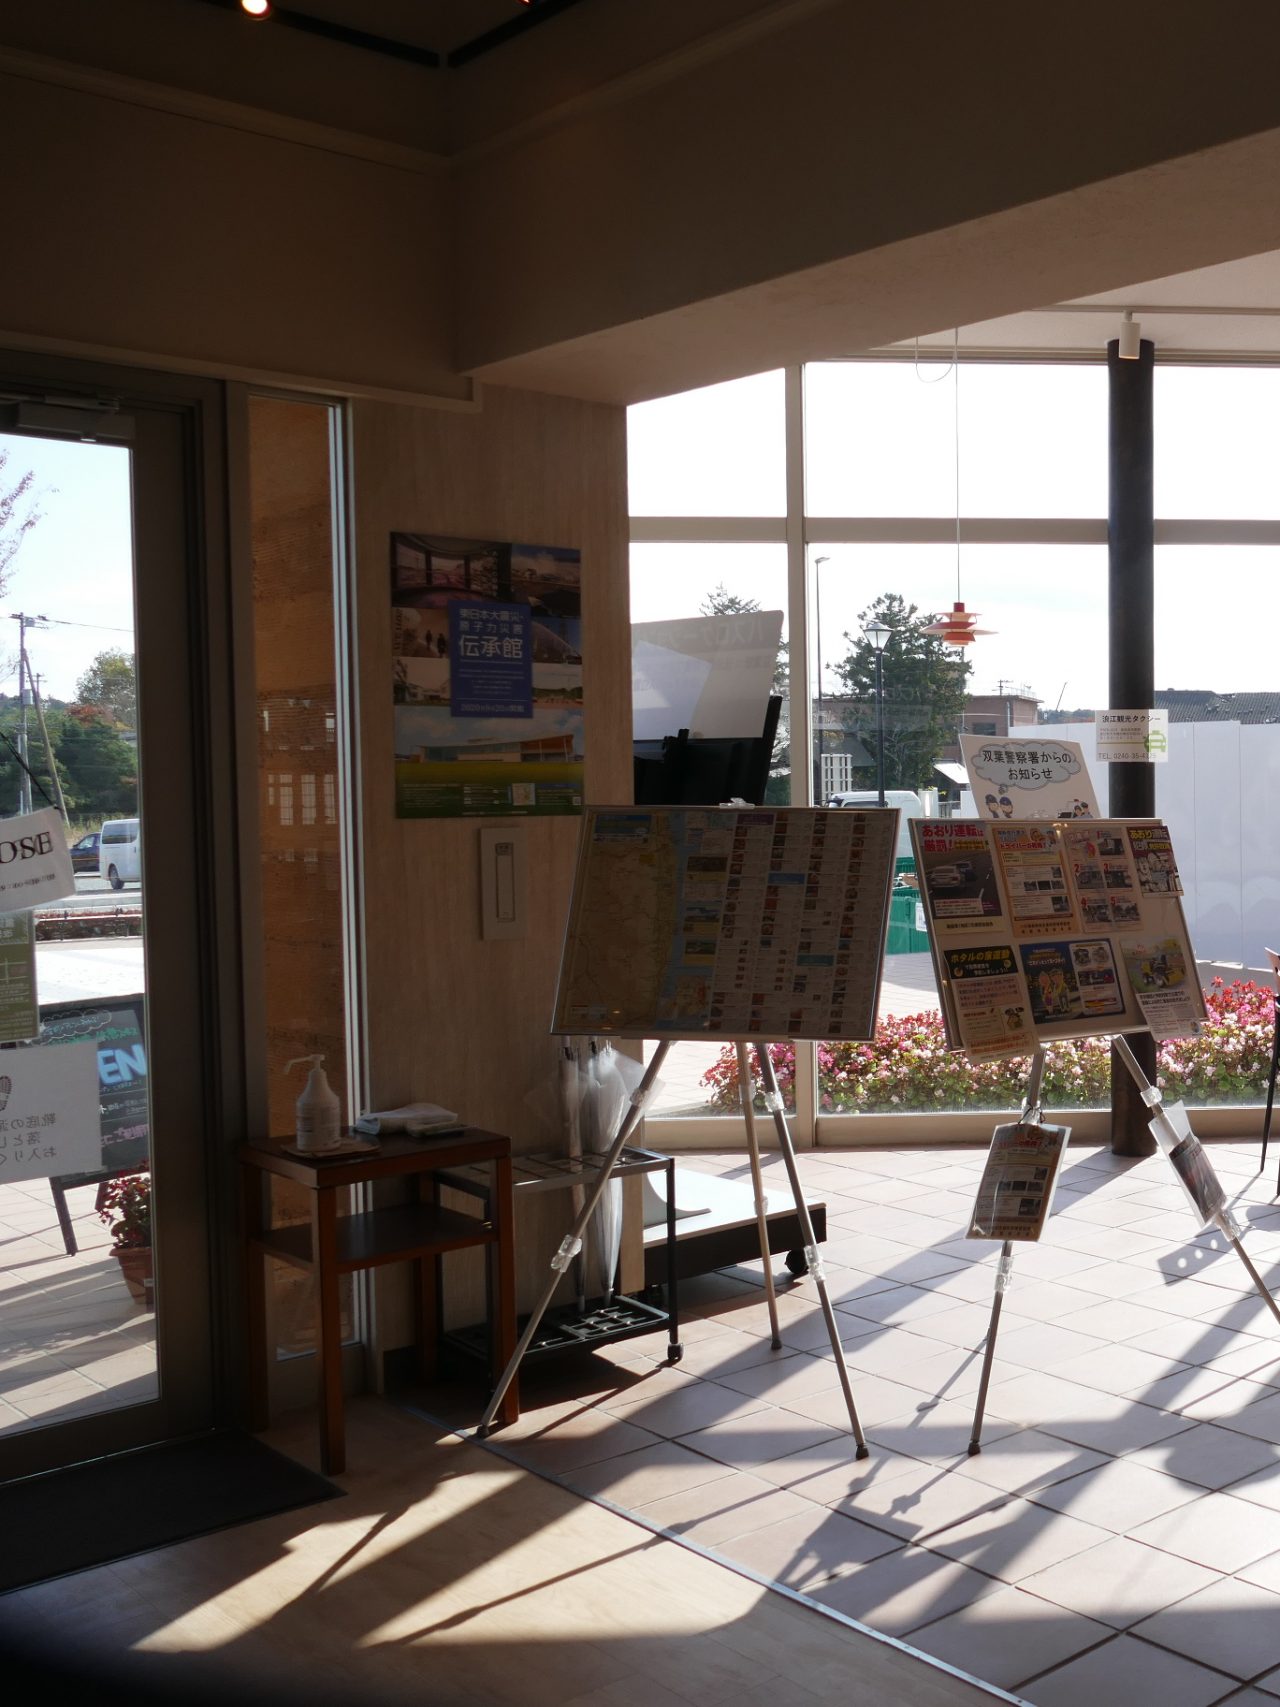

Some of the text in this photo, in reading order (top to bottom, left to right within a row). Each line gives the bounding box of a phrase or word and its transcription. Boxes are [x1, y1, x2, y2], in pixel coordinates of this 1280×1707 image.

[458, 634, 523, 659] 伝承館
[1102, 715, 1161, 724] 浪江観光タクシー
[982, 750, 1072, 765] 双葉警察署からの
[1008, 768, 1053, 781] お知らせ
